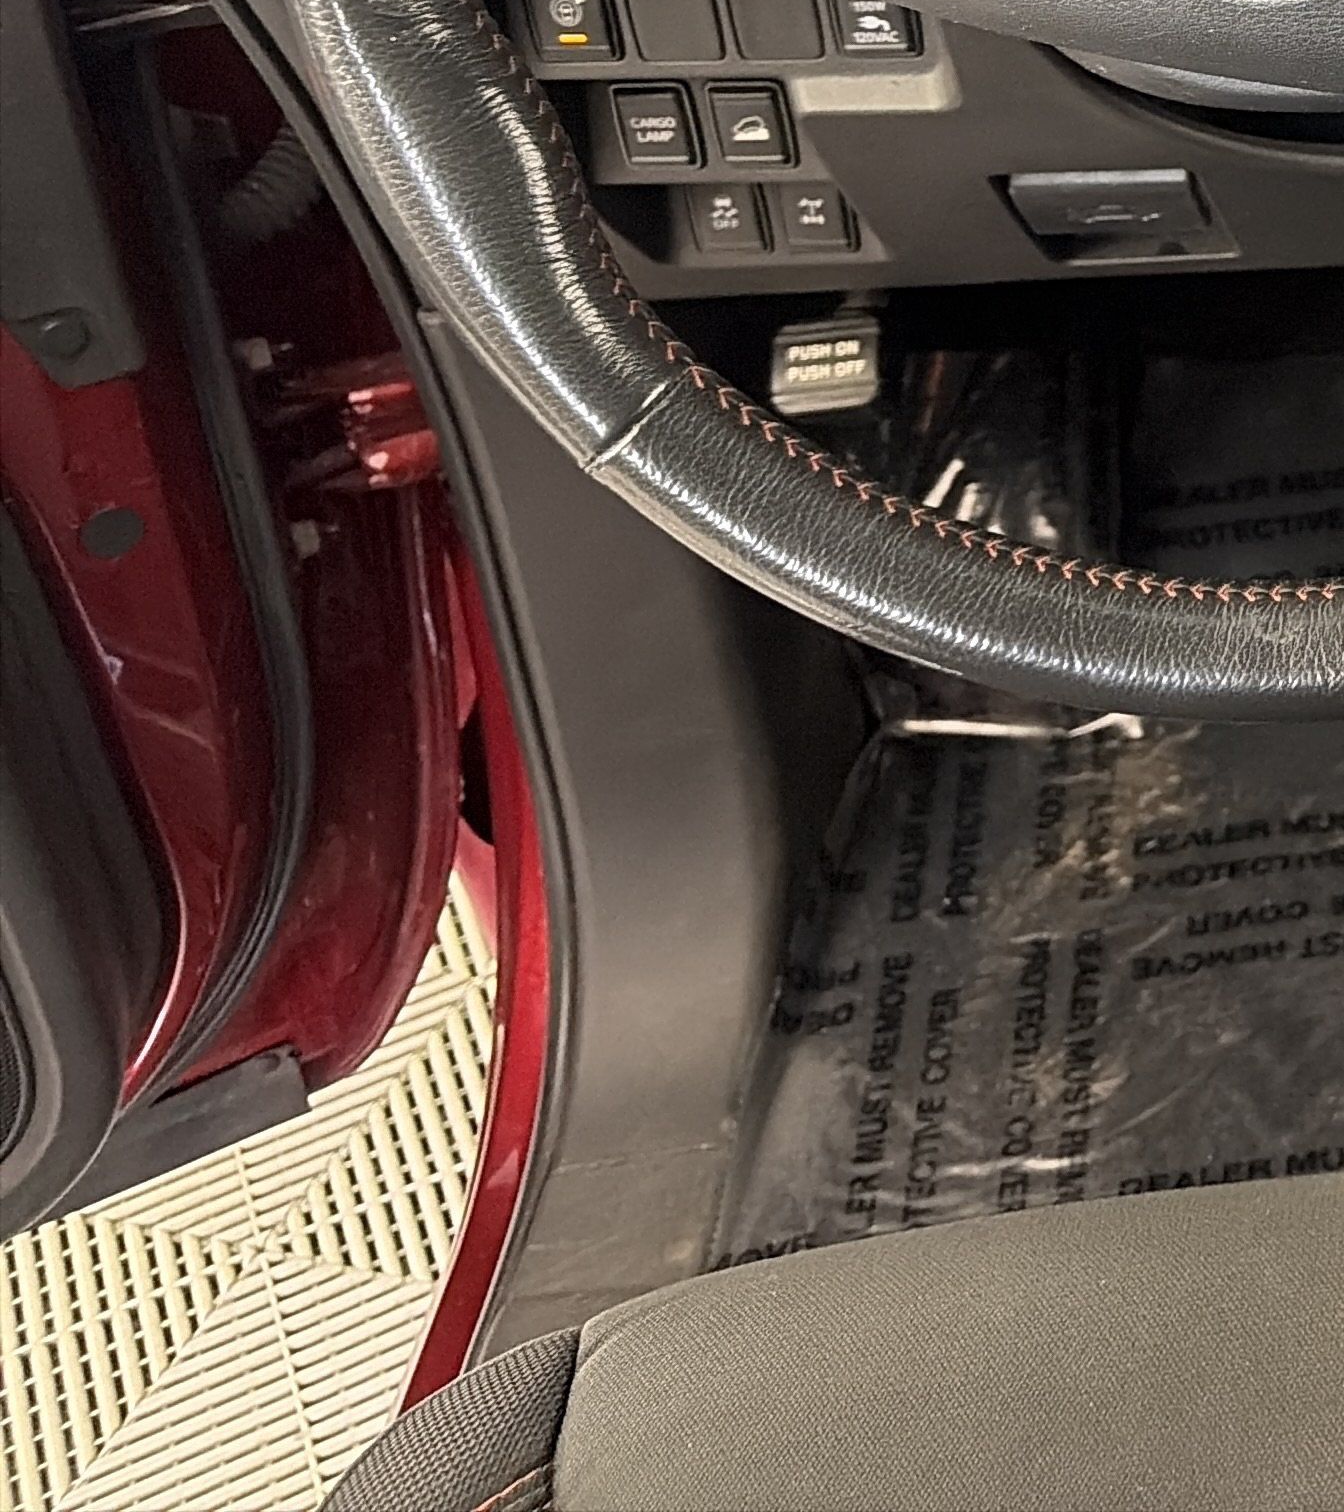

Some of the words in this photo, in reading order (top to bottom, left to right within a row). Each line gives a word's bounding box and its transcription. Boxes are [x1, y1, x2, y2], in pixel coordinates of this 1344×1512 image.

[630, 116, 676, 129] CARGO
[636, 130, 675, 143] LAMP
[787, 343, 832, 362] PUSH
[835, 340, 860, 356] ON
[786, 364, 831, 383] PUSH
[834, 359, 866, 378] OFF
[1130, 939, 1289, 982] REMOVE
[866, 951, 914, 1073] REMOVE
[899, 1094, 949, 1229] TECTIVE
